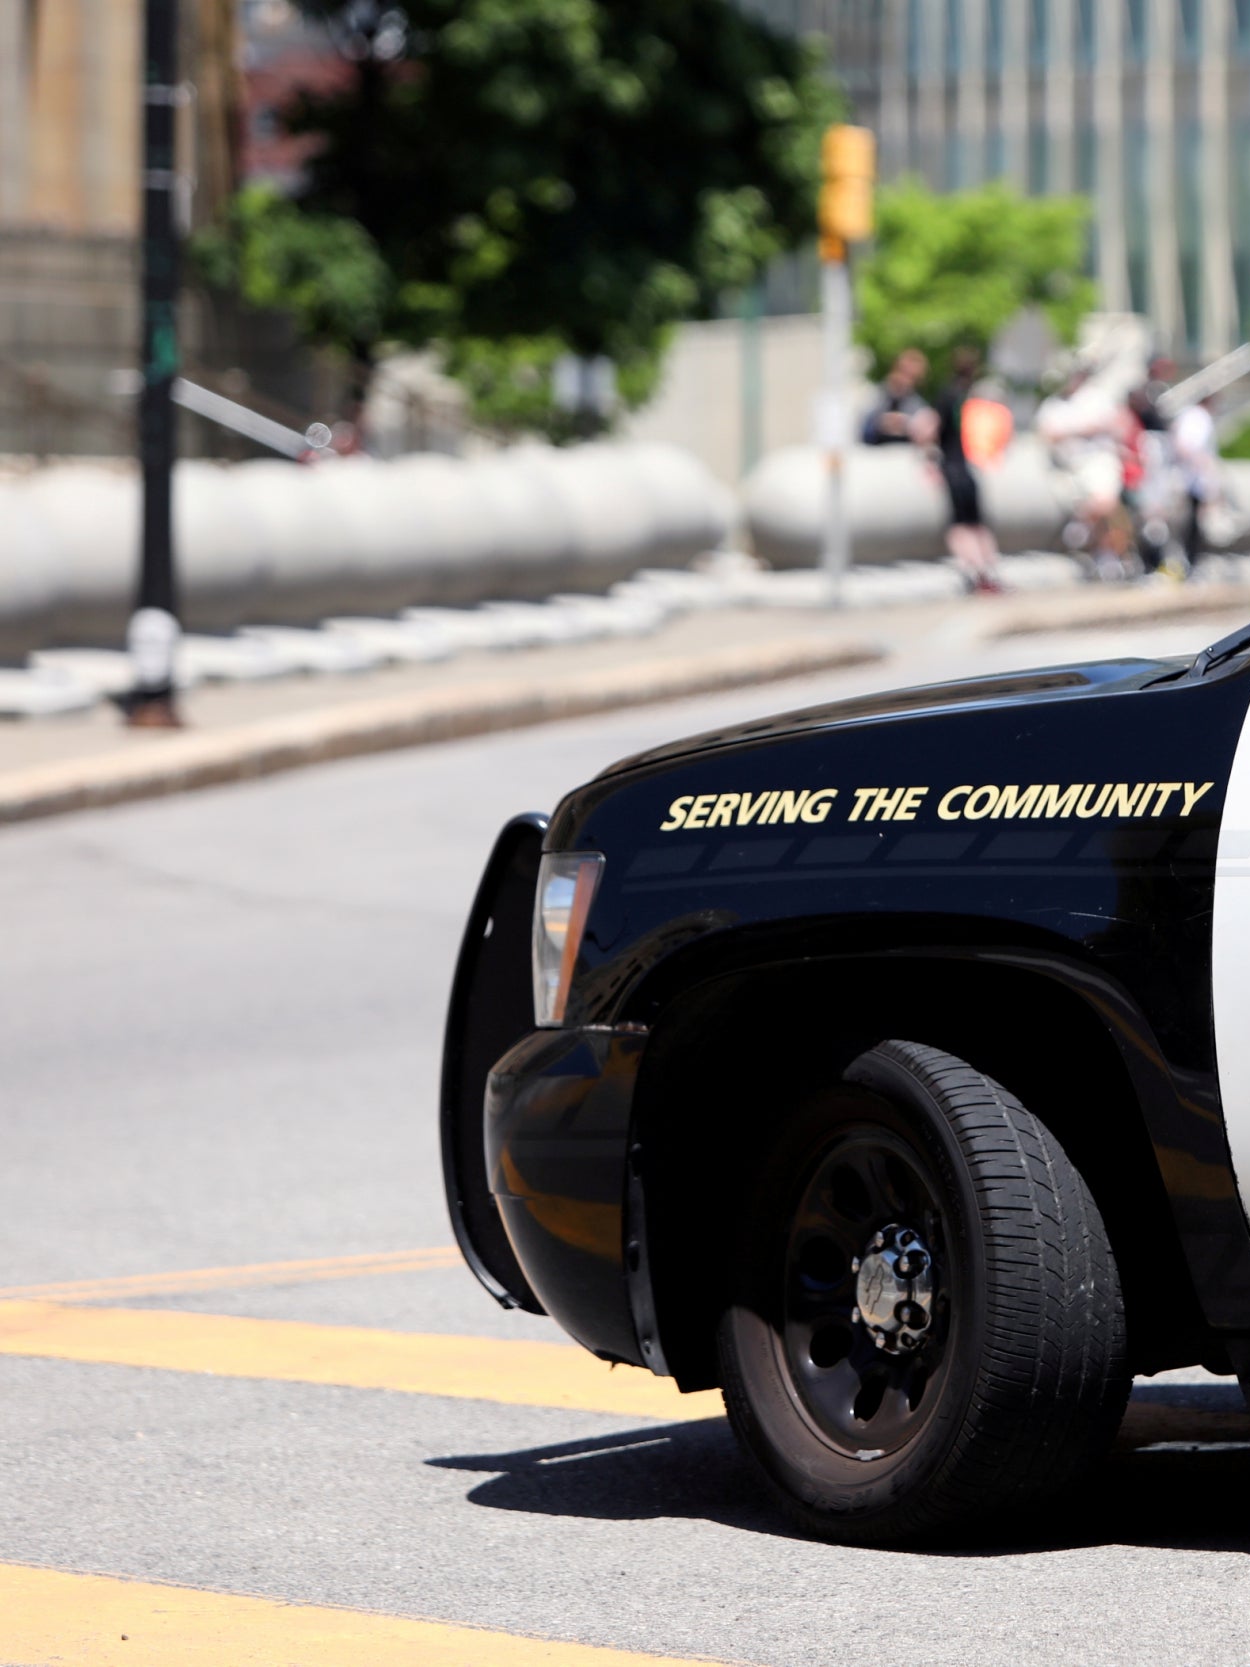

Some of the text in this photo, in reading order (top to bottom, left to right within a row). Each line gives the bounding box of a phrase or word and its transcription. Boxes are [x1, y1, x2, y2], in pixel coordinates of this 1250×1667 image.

[660, 781, 1215, 832] SERVING THE COMMUNITY
